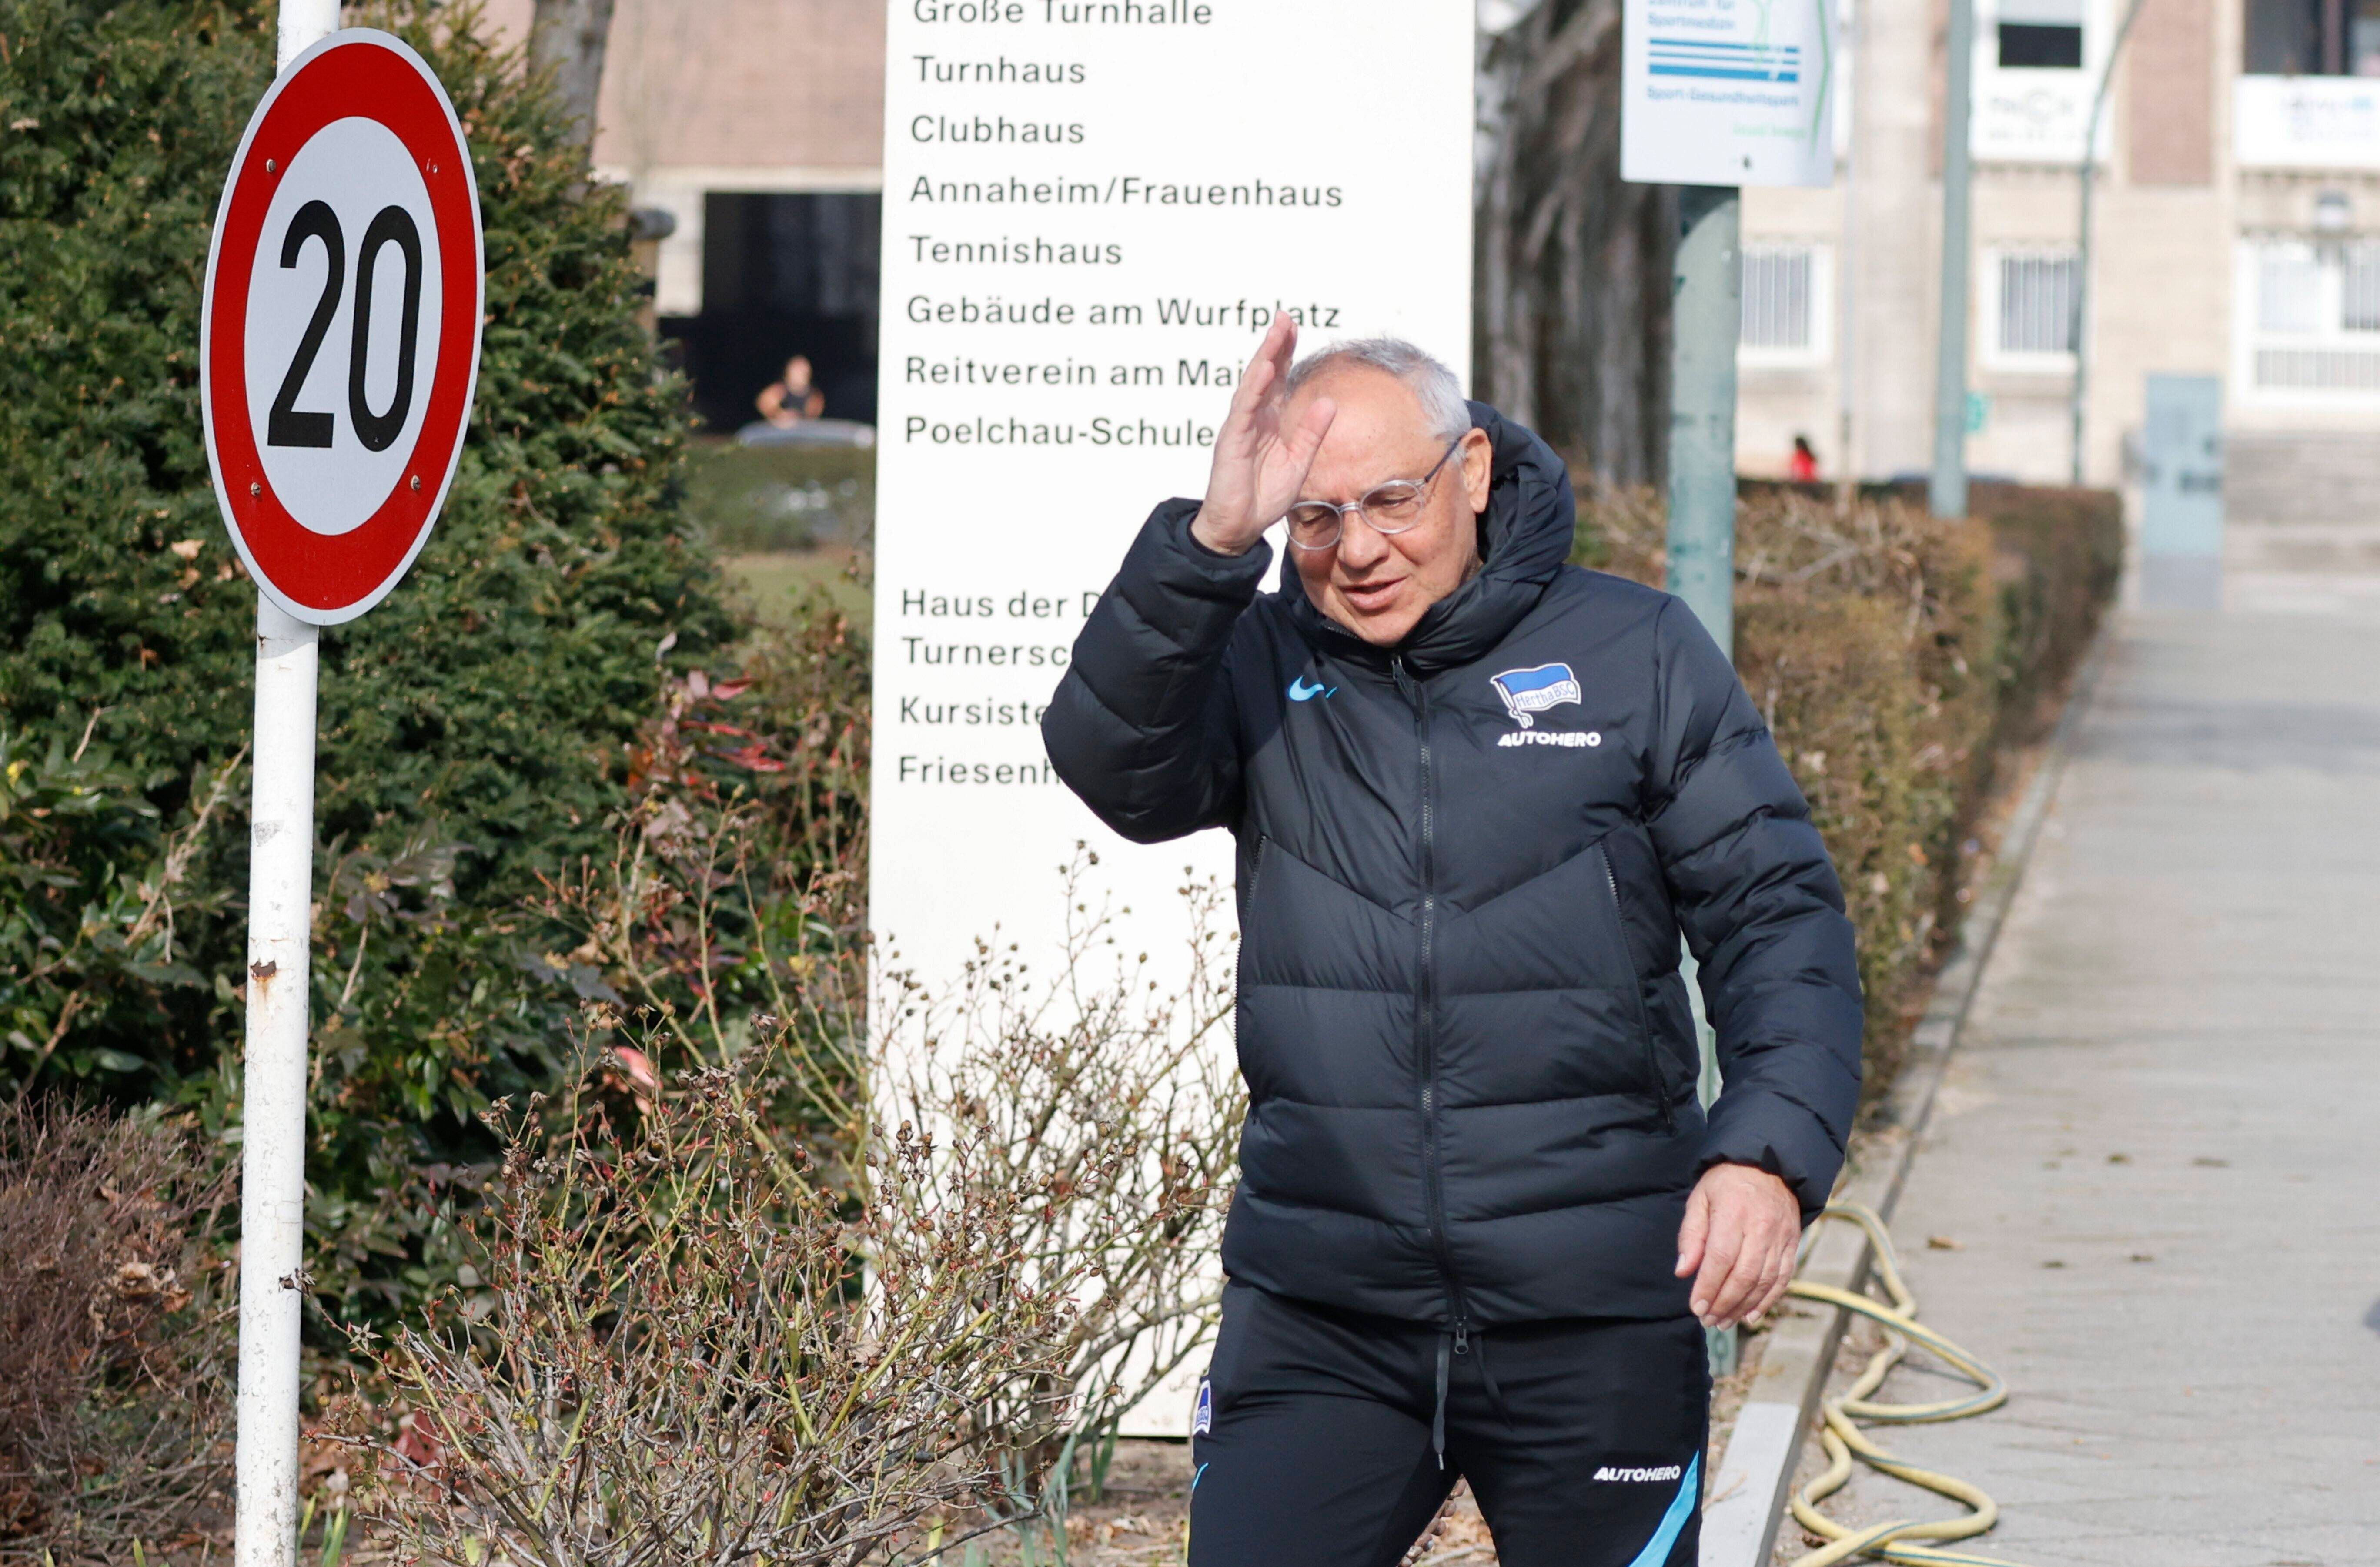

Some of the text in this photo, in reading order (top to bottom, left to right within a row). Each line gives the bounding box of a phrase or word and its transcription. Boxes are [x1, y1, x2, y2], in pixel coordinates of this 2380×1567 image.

[913, 0, 1023, 23] Große
[913, 55, 1085, 84] Turnhaus
[911, 115, 1084, 143] Clubhaus
[910, 176, 1342, 207] Annaheim/Frauenhaus
[909, 236, 1121, 265] Tennishaus
[907, 295, 1074, 324] Gebäude
[1089, 305, 1142, 324] am
[267, 200, 423, 452] 20
[907, 356, 1244, 386] Reitverein am Mai
[906, 416, 1214, 447] Poelchau-Schule
[903, 589, 993, 617] Haus
[1008, 591, 1067, 618] der
[902, 637, 1068, 666] Turnersc
[901, 696, 1047, 725] Kursiste
[1497, 731, 1601, 747] AUTOHERO
[899, 756, 1060, 784] Friesenh
[1593, 1465, 1681, 1482] AUTOHERO
